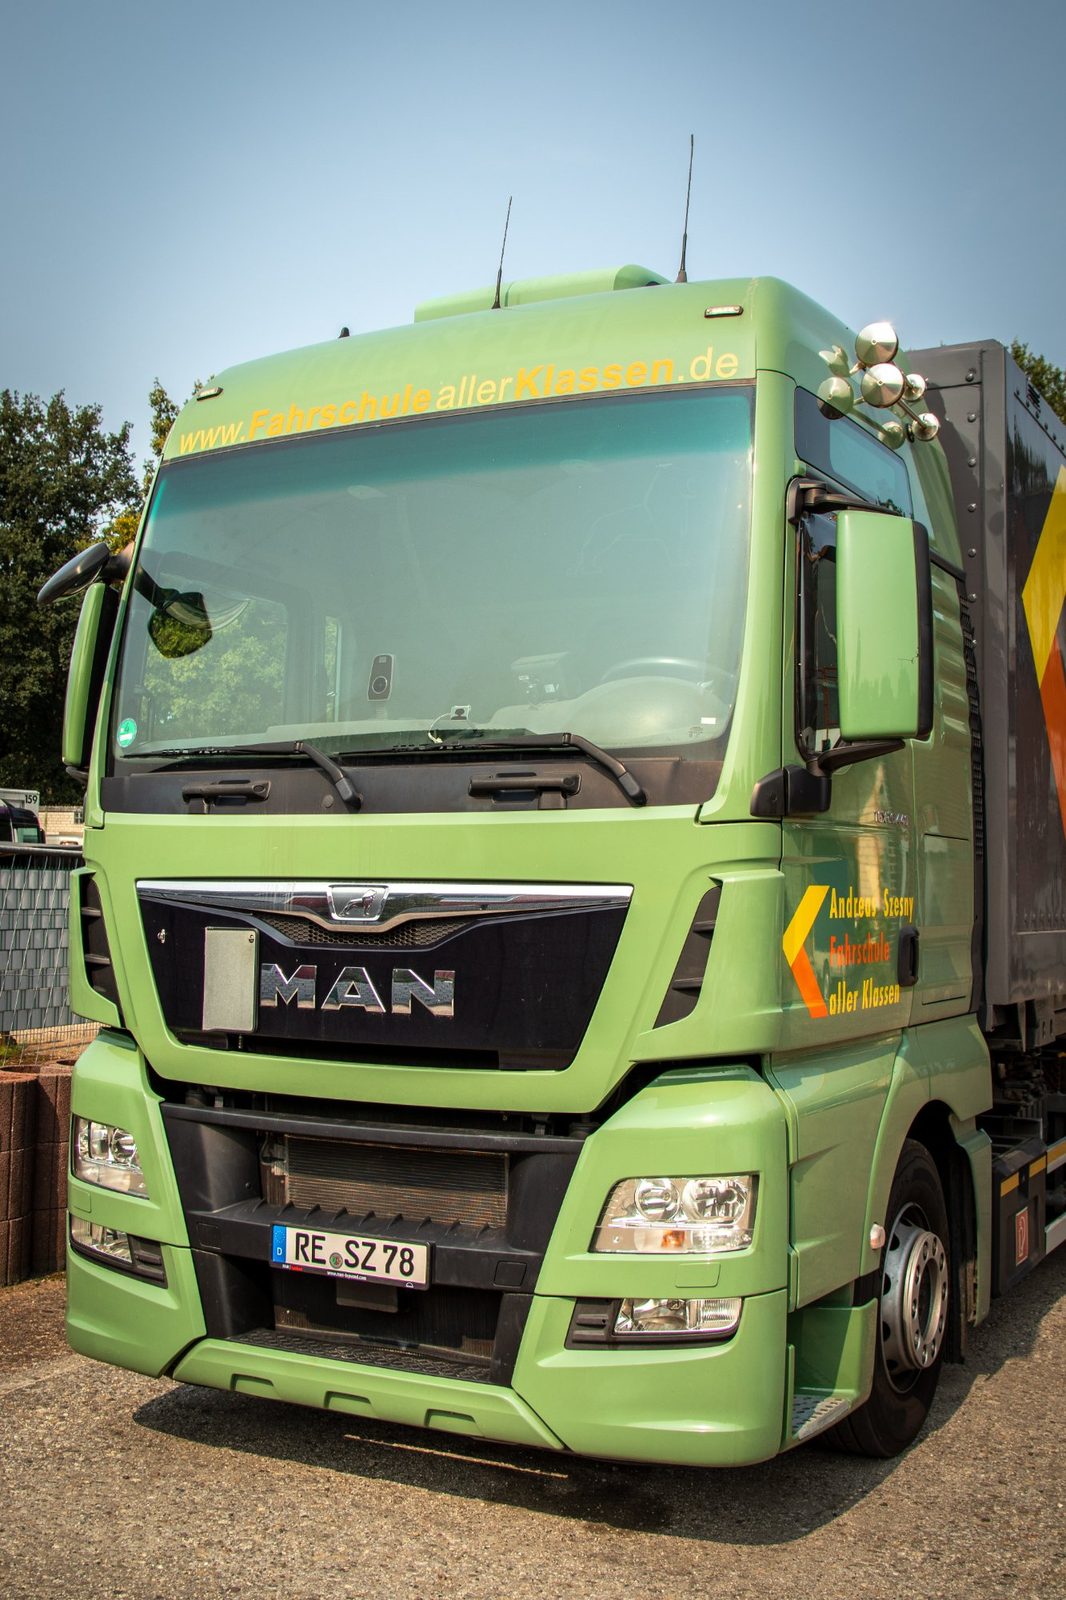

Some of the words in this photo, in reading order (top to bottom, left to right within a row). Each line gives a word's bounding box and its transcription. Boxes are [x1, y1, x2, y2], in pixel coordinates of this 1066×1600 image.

[25, 794, 38, 804] 159
[829, 886, 877, 919] Andreas
[883, 888, 914, 923] Szesny
[829, 932, 890, 967] Fahrschule
[260, 963, 456, 1017] MAN
[829, 981, 859, 1016] aller
[862, 977, 900, 1009] Klassen
[276, 1247, 283, 1256] D
[295, 1232, 326, 1265] RE
[344, 1239, 376, 1271] SZ
[383, 1244, 414, 1277] 78
